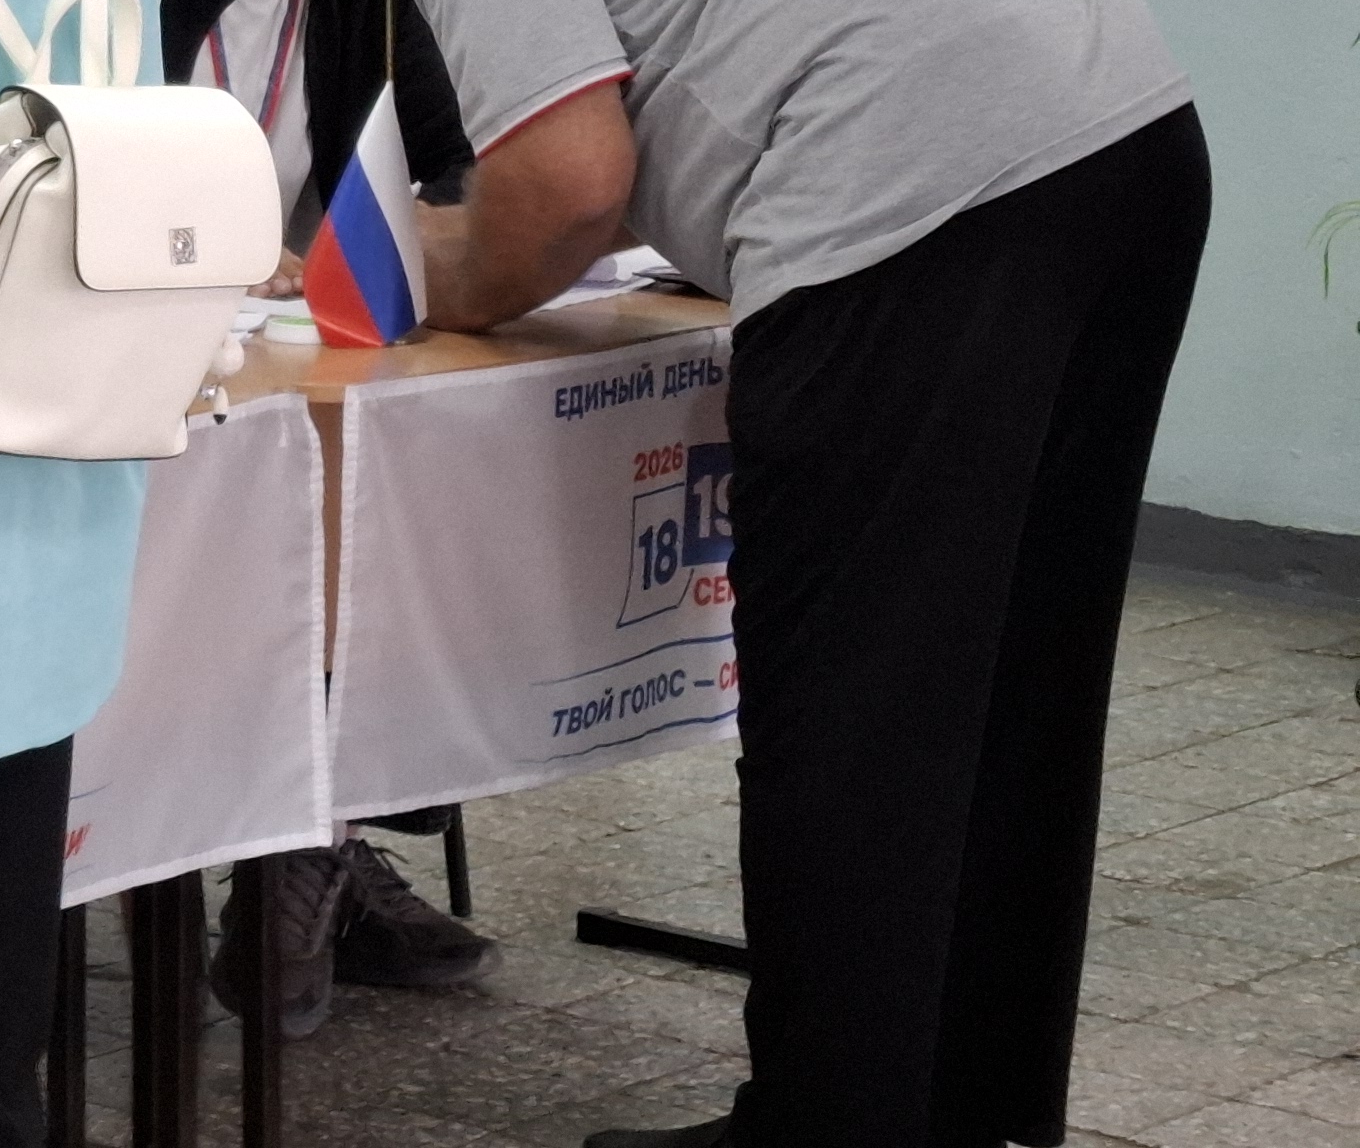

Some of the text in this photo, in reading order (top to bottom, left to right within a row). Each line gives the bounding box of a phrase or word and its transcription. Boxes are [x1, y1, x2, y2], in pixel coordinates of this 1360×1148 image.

[555, 357, 724, 421] ЕДИНЫЙ ДЕНЬ
[634, 441, 684, 482] 2026
[638, 519, 678, 590] 18
[552, 687, 613, 737] ТВОЙ
[618, 668, 686, 718] ГОЛОС
